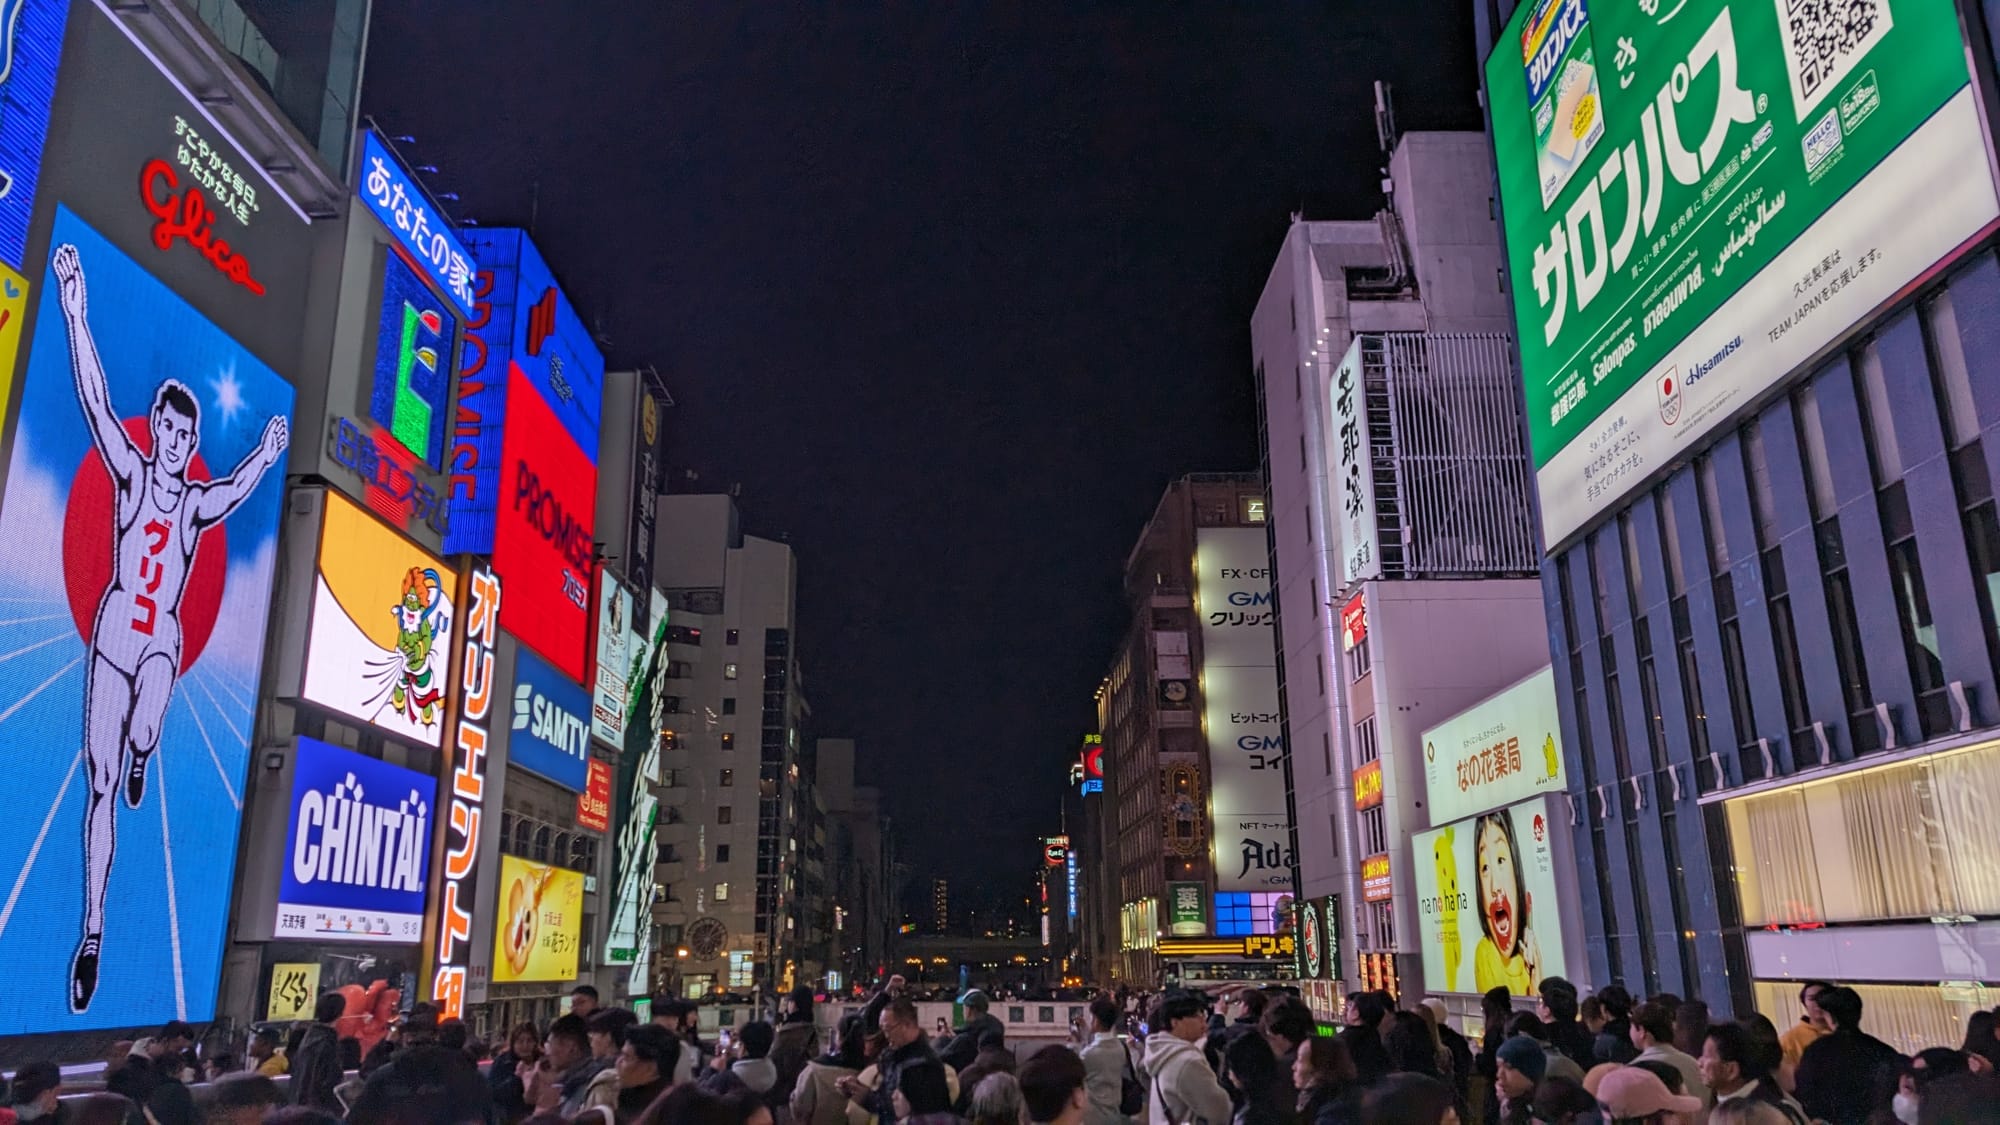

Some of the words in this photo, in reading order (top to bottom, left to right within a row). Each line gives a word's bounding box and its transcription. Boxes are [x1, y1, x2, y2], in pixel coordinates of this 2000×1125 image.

[177, 143, 250, 226] ゆたかな人生
[141, 158, 266, 297] Glico
[1793, 248, 1842, 299] 久光製薬は
[1768, 317, 1793, 343] TEAM
[1593, 331, 1637, 387] Salonpas
[1685, 335, 1743, 386] Hisamitsu
[515, 459, 593, 578] PROMISE
[130, 518, 173, 637] グリコ
[531, 693, 590, 761] SAMTY
[1457, 736, 1521, 793] なの花薬局
[293, 772, 425, 893] CHINTAI
[1240, 822, 1259, 830] NFT
[1176, 887, 1199, 909] 薬
